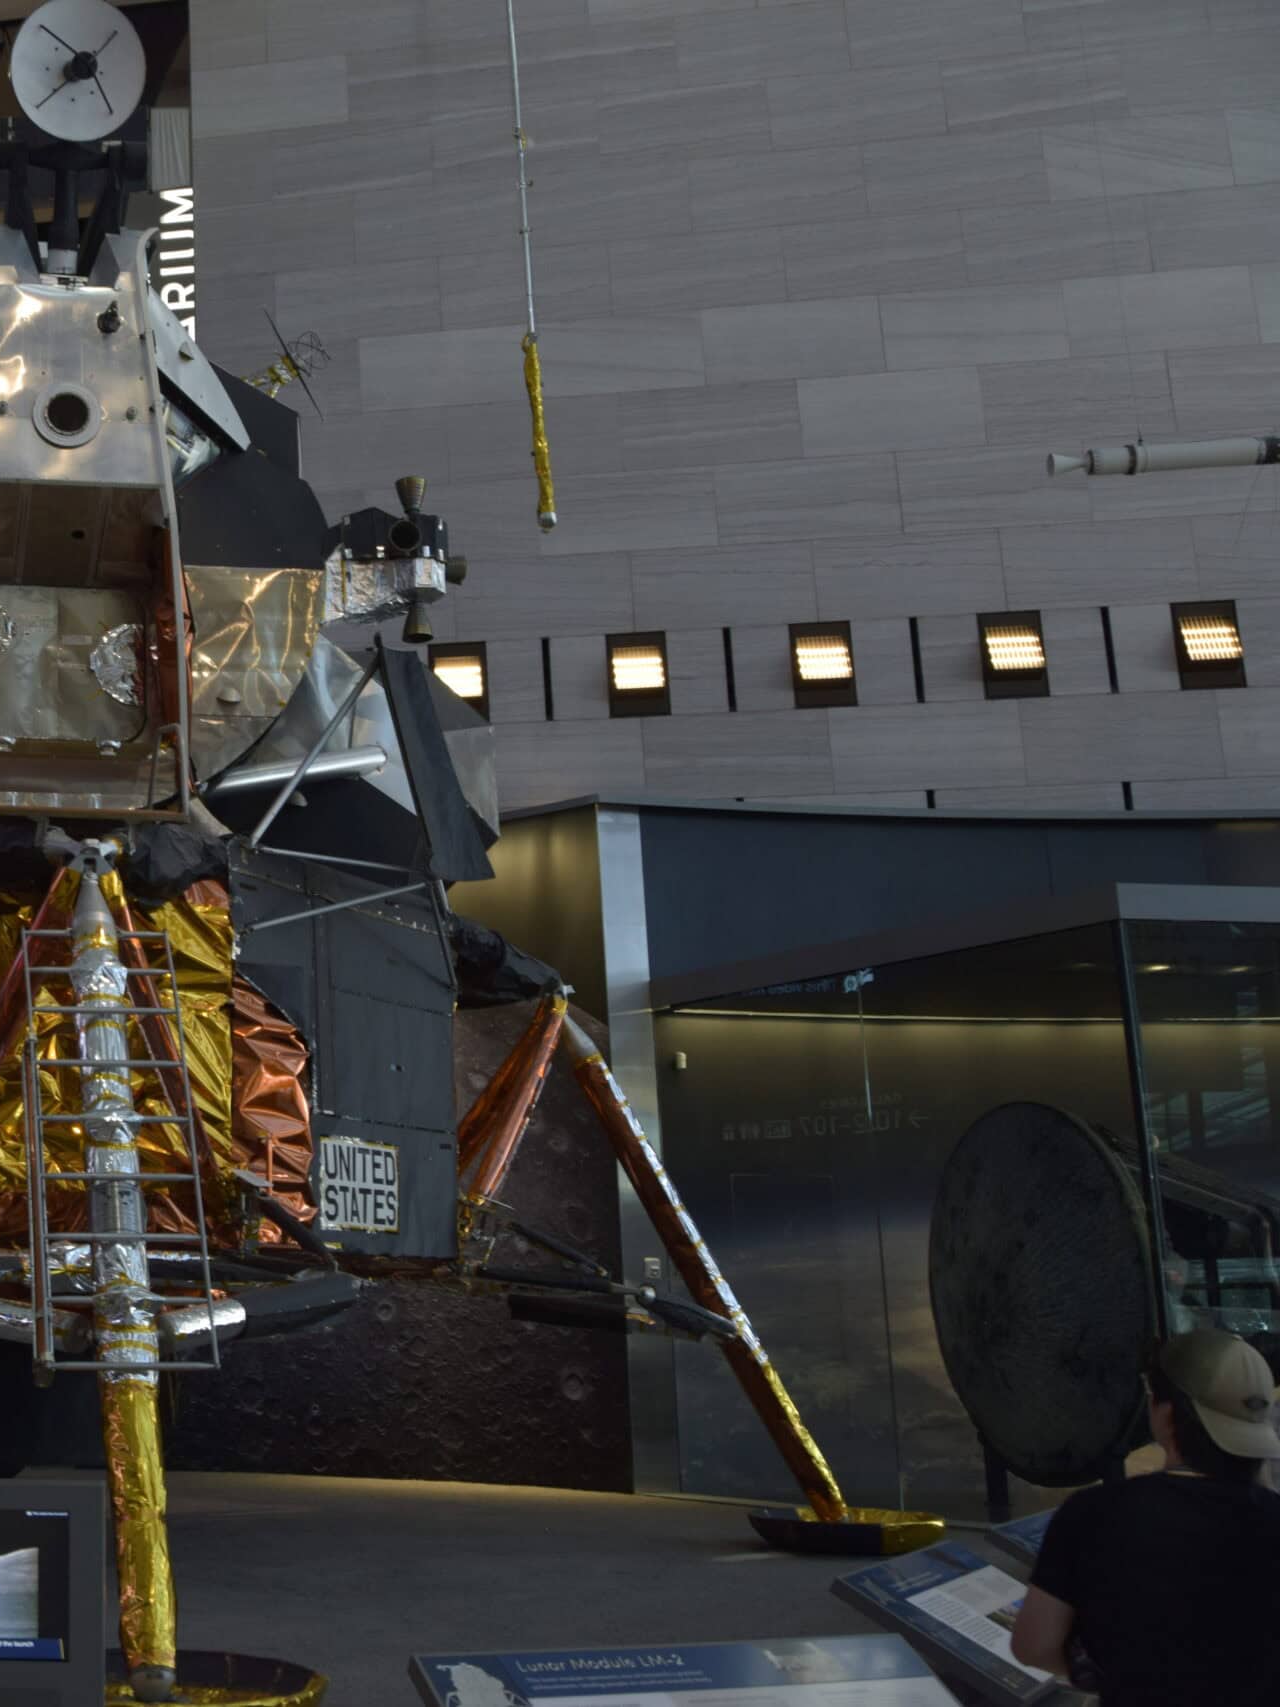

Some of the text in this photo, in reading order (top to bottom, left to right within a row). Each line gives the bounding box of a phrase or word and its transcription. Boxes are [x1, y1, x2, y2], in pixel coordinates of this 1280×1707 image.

[324, 1144, 396, 1186] UNITED
[325, 1185, 396, 1226] STATES
[516, 1654, 686, 1673] Lunar Module LM-2
